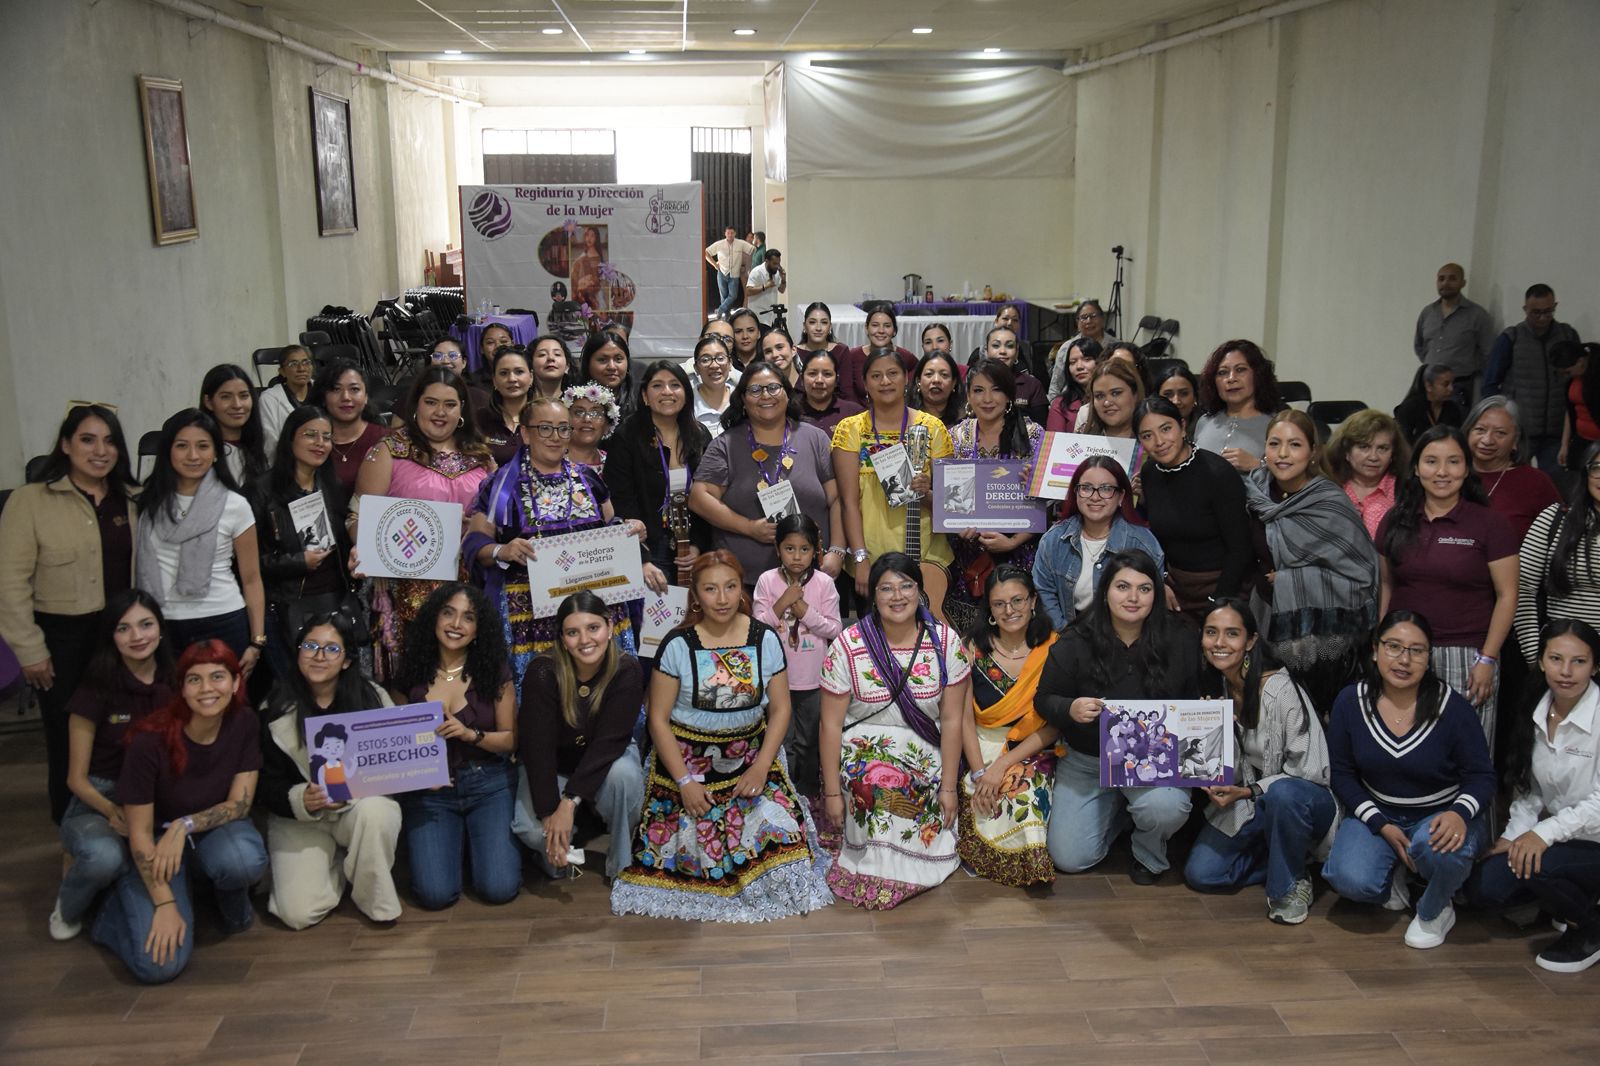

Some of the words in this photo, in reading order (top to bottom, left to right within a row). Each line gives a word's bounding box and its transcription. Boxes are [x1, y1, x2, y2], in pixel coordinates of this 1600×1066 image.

[514, 186, 575, 201] Regiduría
[577, 190, 584, 201] y
[588, 186, 644, 199] Dirección
[546, 205, 561, 216] de
[564, 205, 575, 216] la
[579, 205, 614, 219] Mujer
[1086, 446, 1118, 455] Tejedoras
[986, 483, 1006, 491] ESTOS
[1007, 483, 1020, 491] SON
[413, 508, 436, 536] Tejedoras
[431, 538, 438, 548] de
[427, 548, 435, 557] la
[577, 546, 615, 559] Tejedoras
[589, 554, 613, 564] Patria
[409, 555, 429, 569] Patria
[565, 574, 593, 585] Llegamos
[594, 570, 610, 578] todas
[358, 738, 388, 752] ESTOS
[390, 735, 412, 748] SON
[417, 734, 434, 744] TUS
[357, 744, 440, 768] DERECHOS
